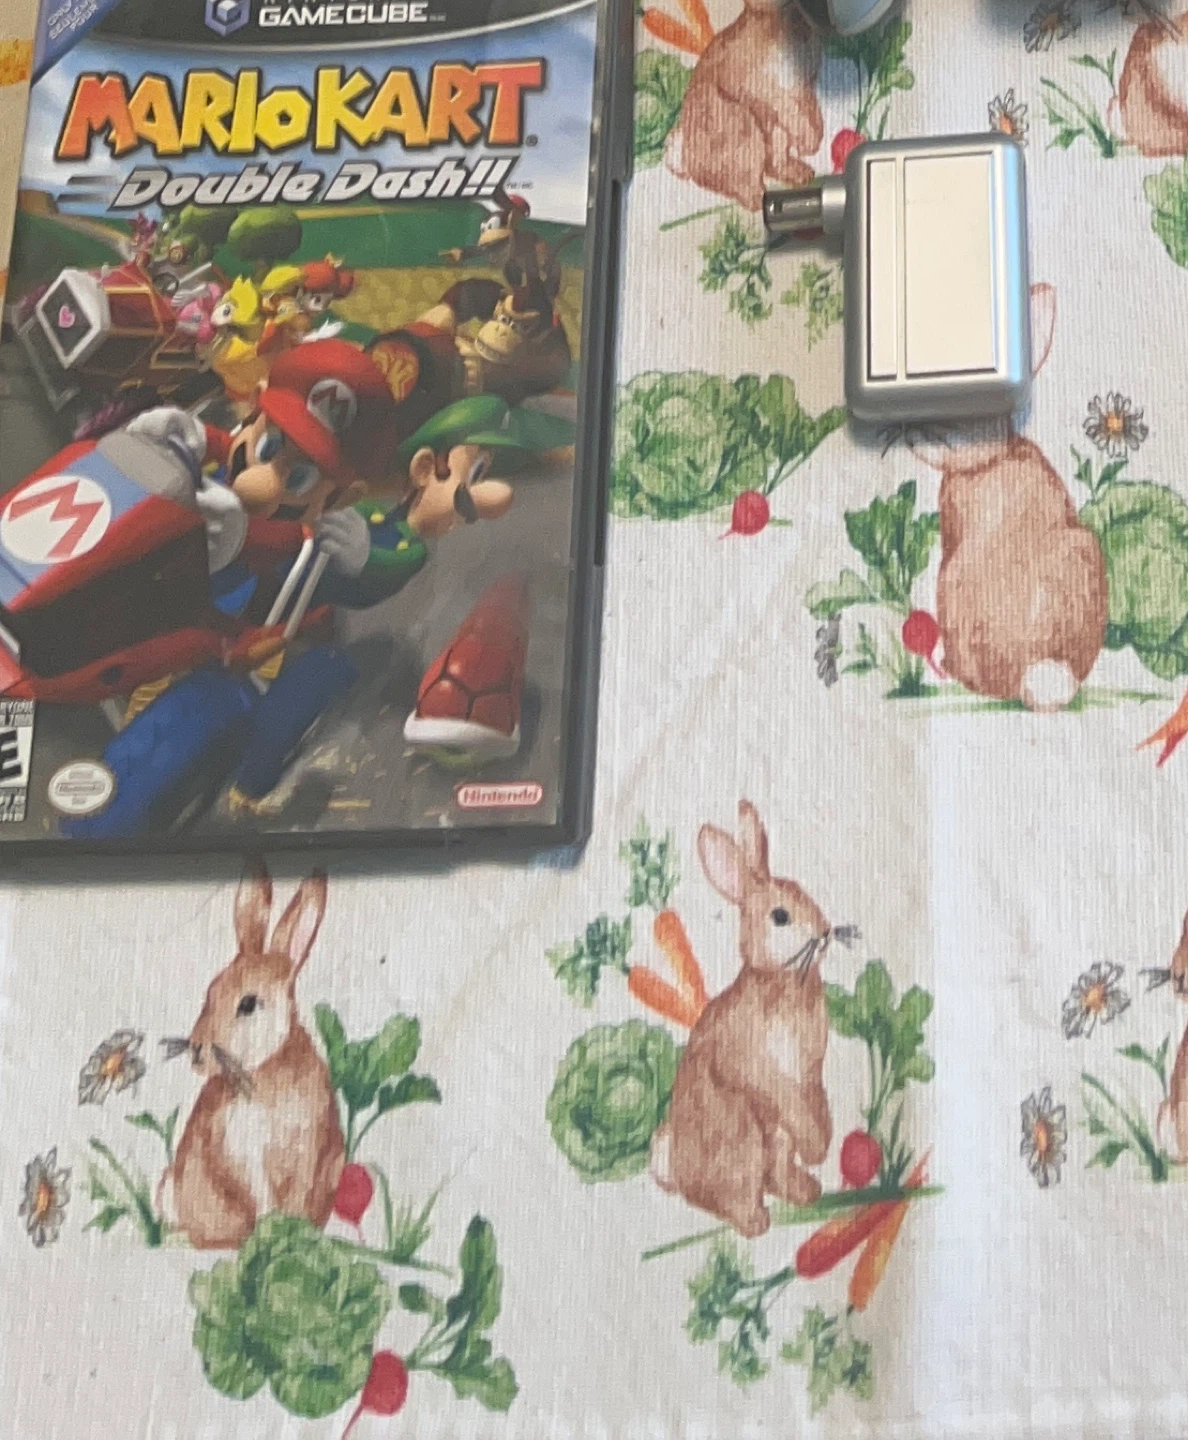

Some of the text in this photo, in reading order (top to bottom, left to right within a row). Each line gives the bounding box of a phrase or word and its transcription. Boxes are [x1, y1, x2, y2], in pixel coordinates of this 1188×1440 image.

[258, 1, 429, 27] GAMECUBE
[54, 56, 546, 160] MARIO KART
[108, 156, 520, 210] Double Dash!!
